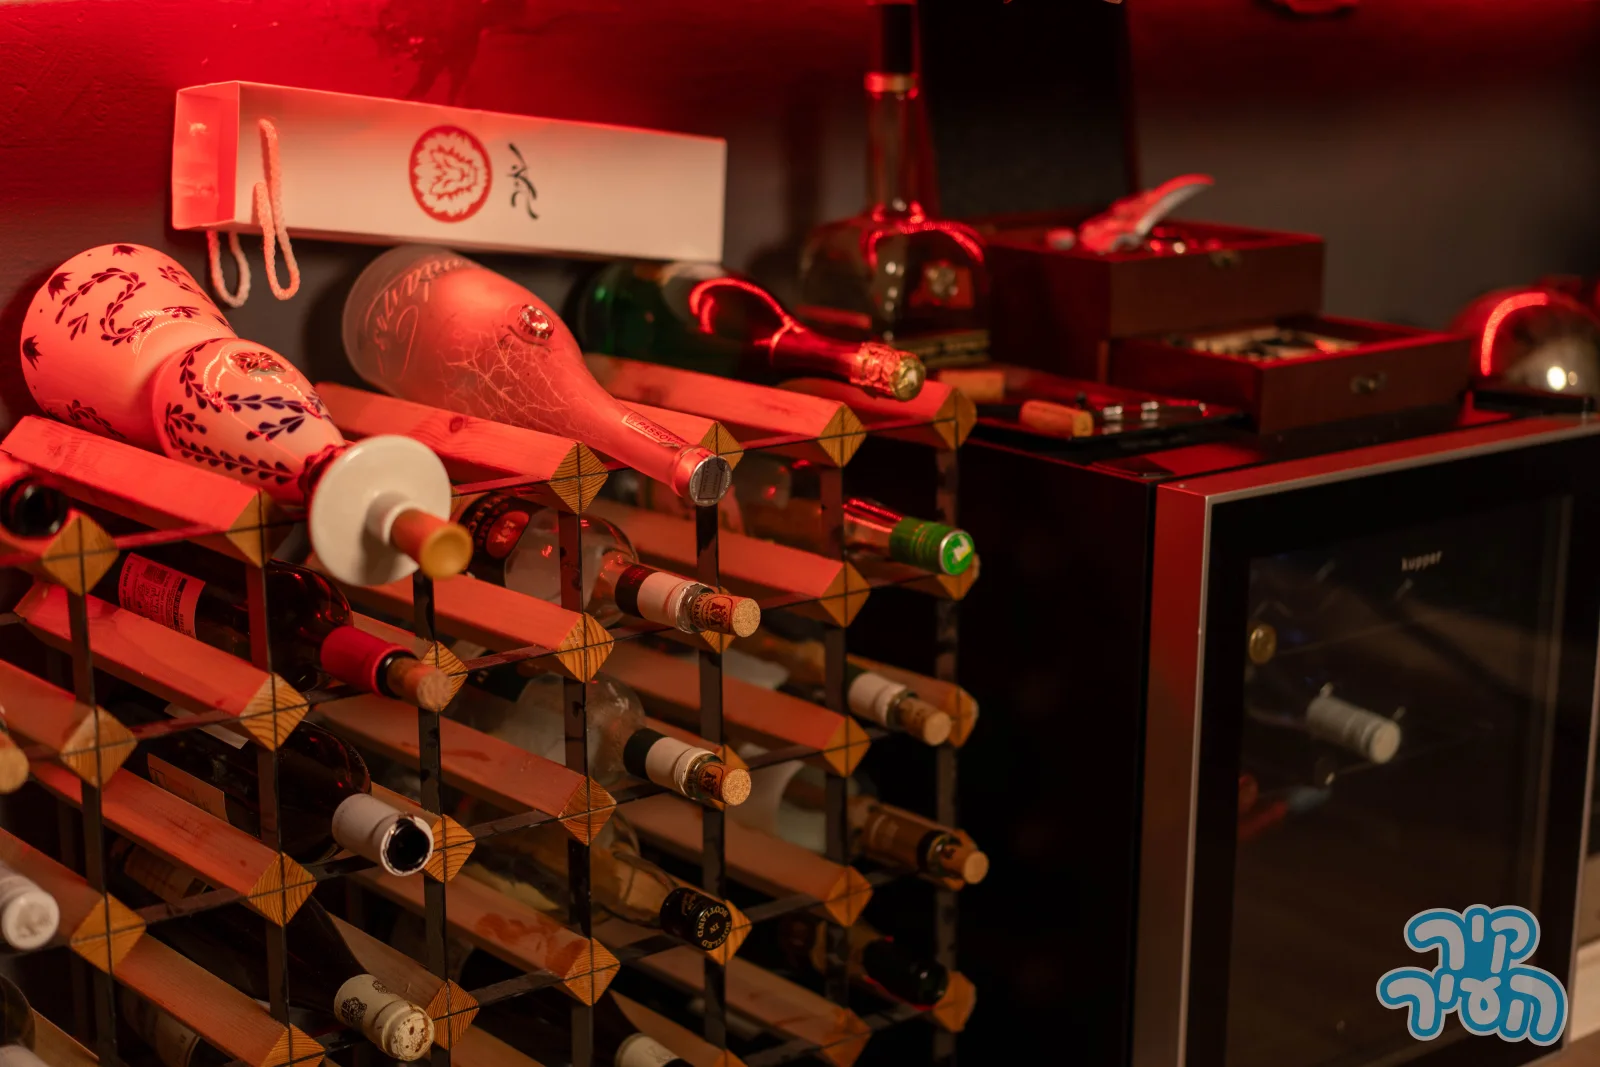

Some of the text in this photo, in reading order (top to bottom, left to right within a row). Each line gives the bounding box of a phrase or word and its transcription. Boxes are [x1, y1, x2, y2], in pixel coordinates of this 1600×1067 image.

[637, 420, 681, 446] PASSOV
[697, 905, 729, 938] SCOTLAND
[701, 921, 731, 949] BOTTLED
[709, 923, 720, 934] IN
